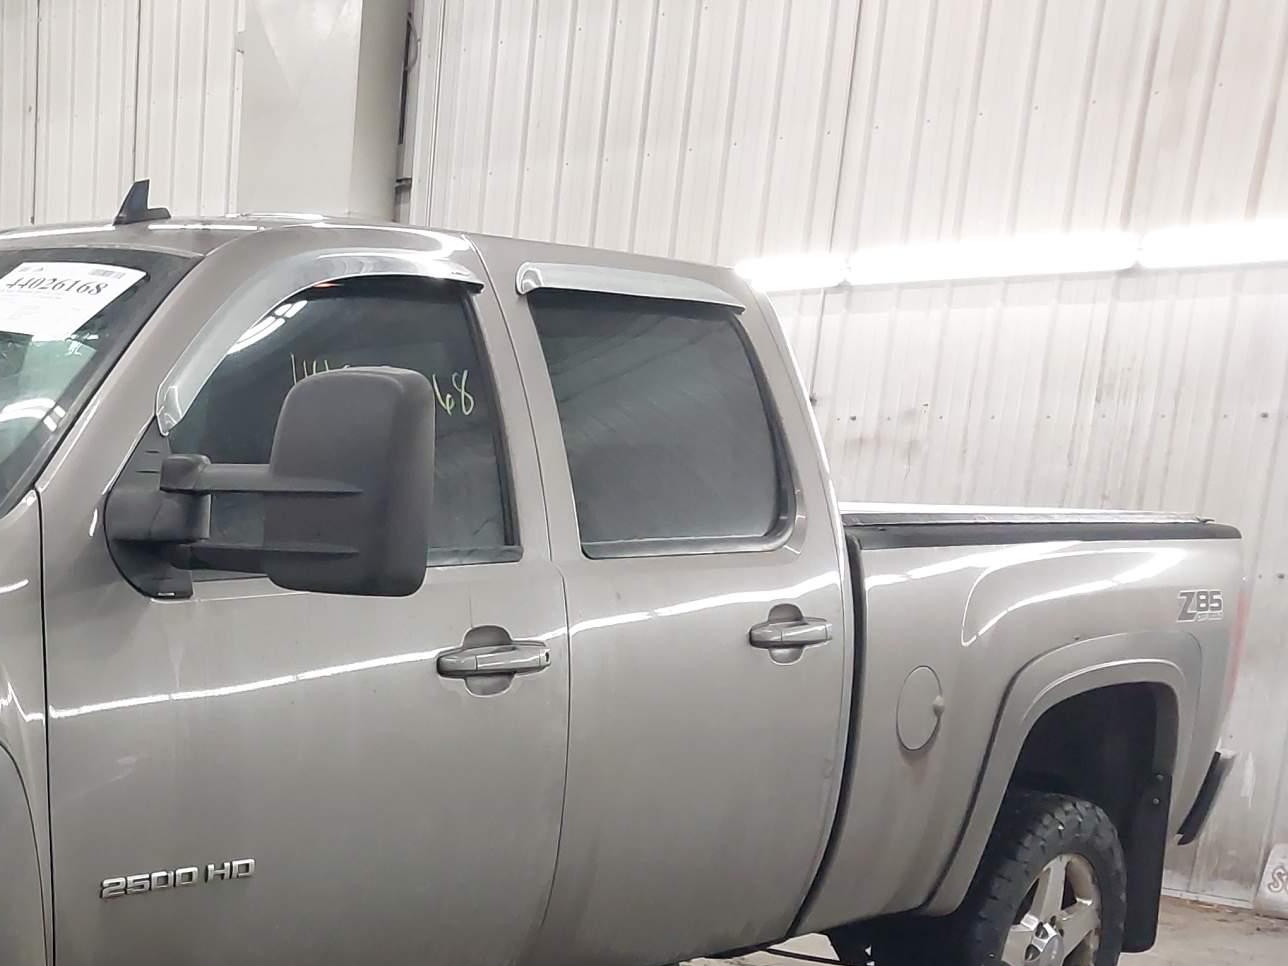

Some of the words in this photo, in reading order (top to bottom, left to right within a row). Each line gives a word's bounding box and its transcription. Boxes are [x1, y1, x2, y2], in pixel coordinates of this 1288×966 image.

[6, 277, 109, 296] 44026168
[1176, 588, 1224, 622] Z85
[100, 866, 199, 899] 2500
[206, 858, 256, 883] HD
